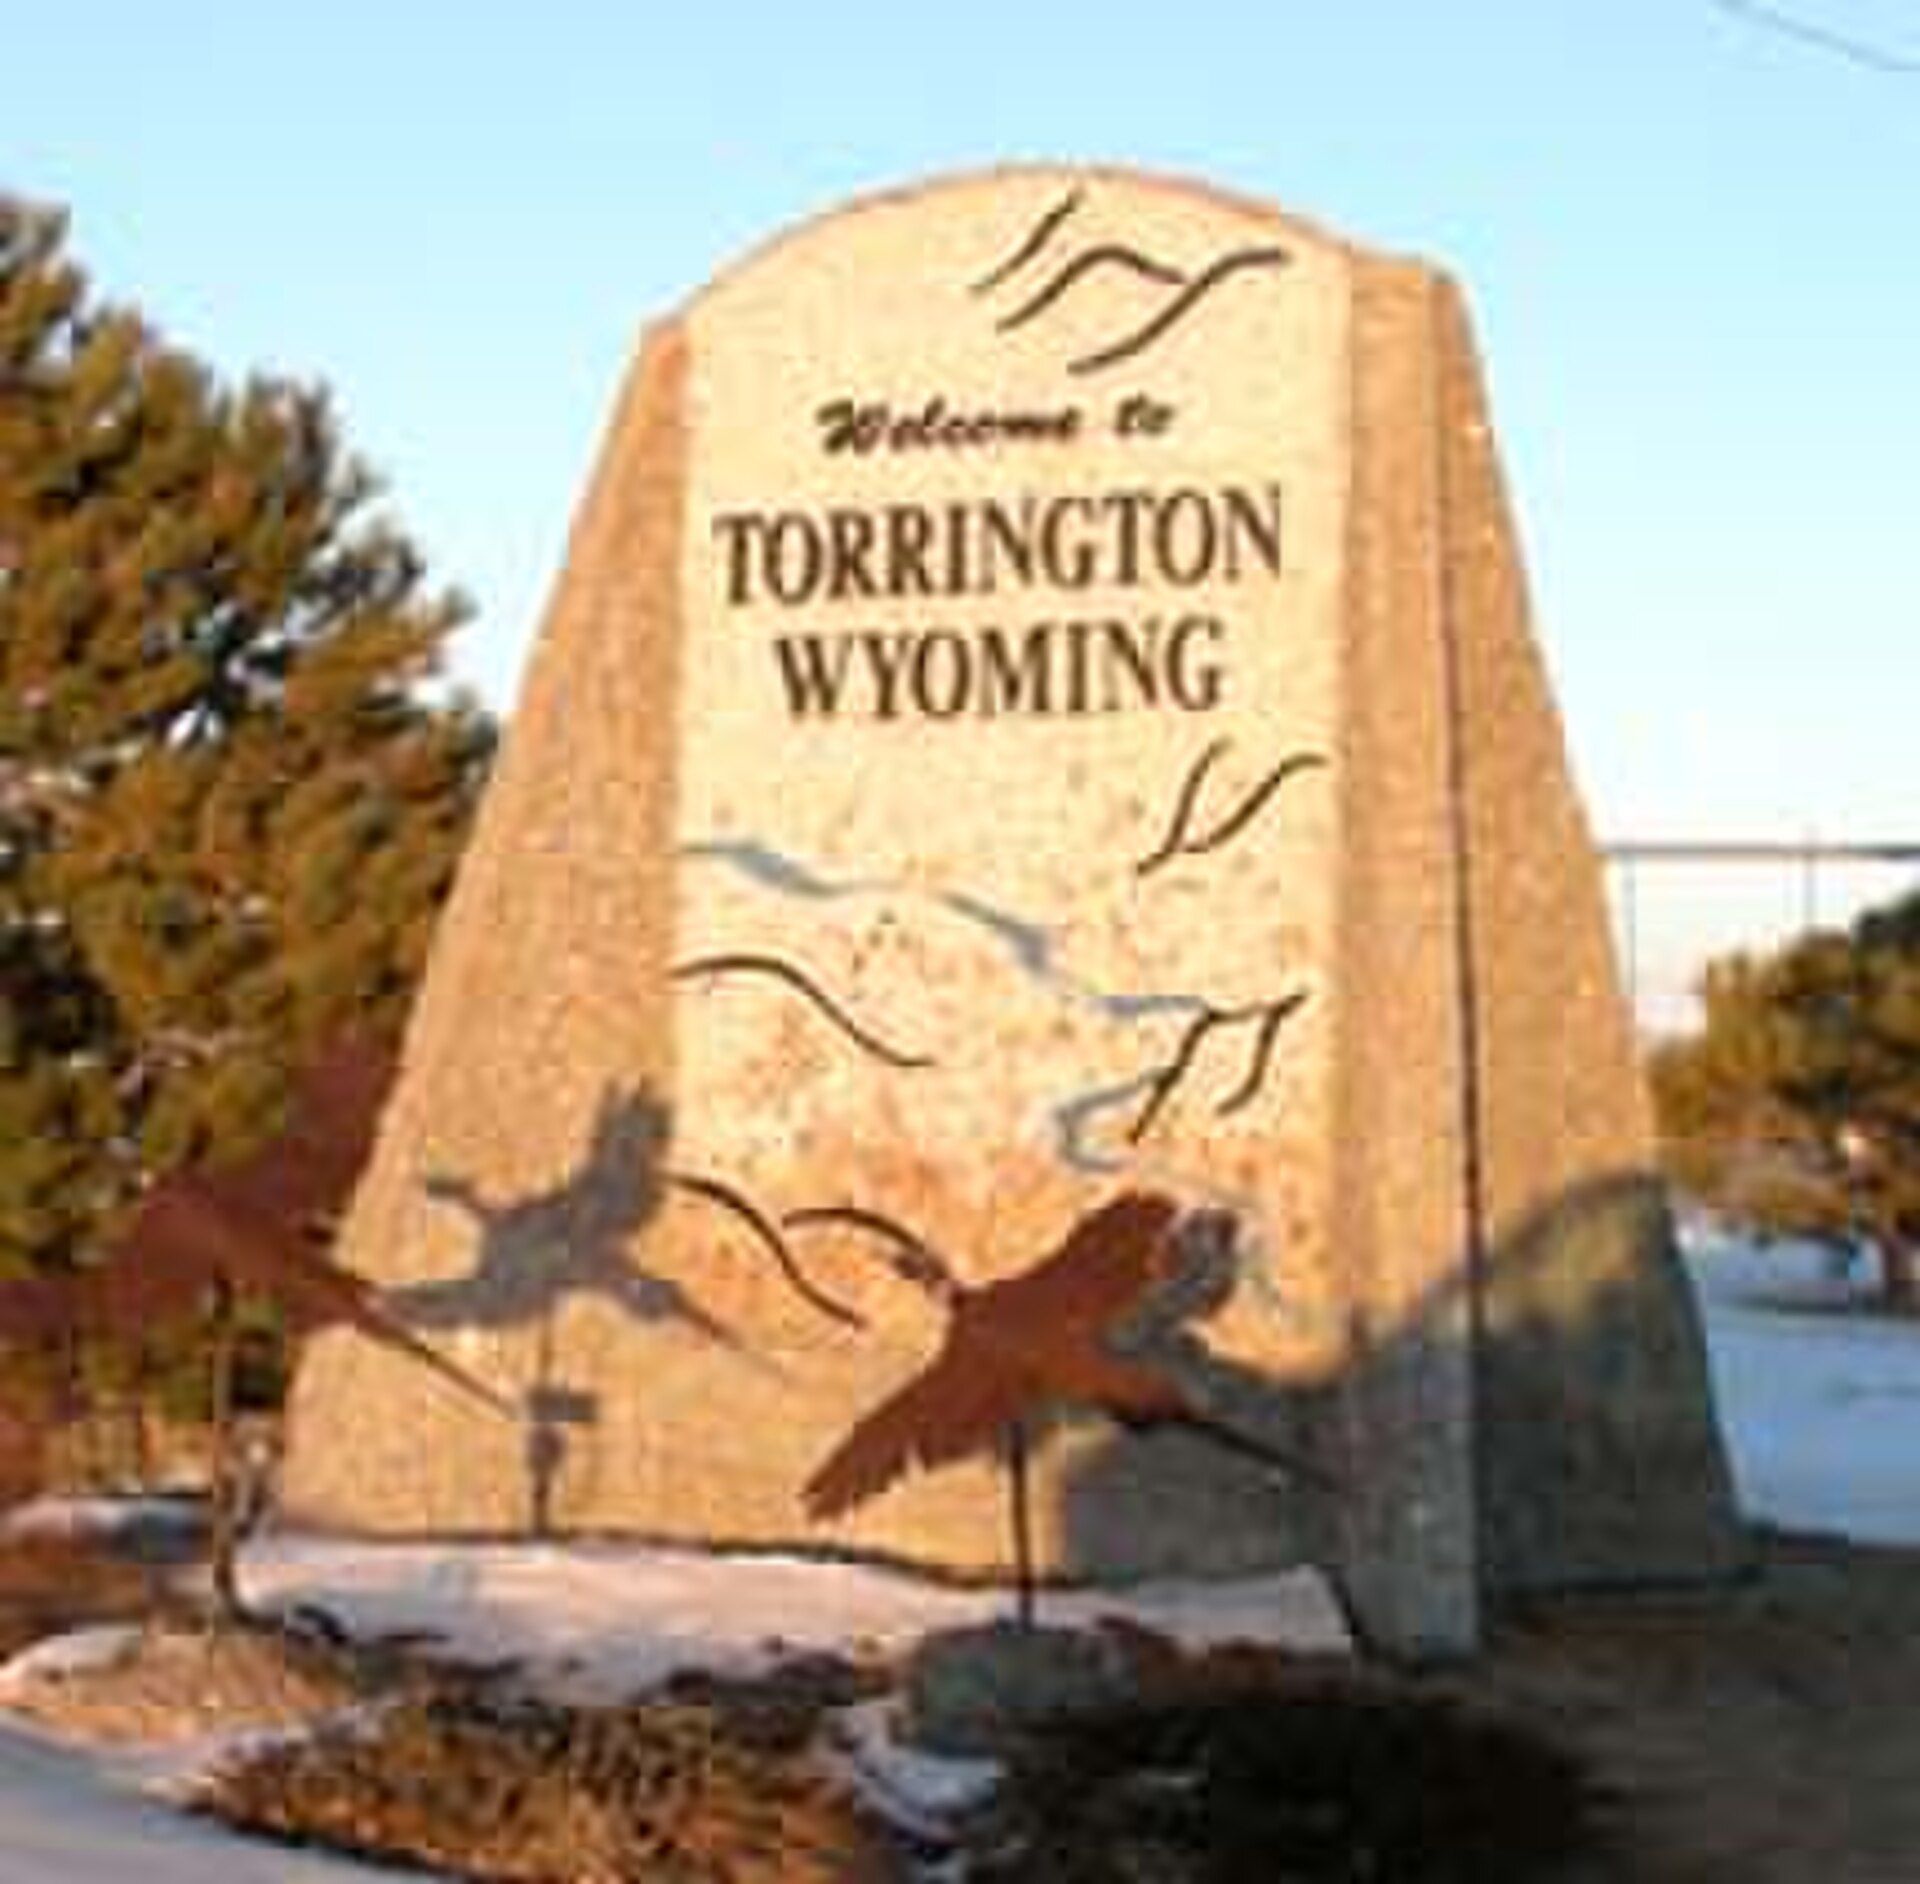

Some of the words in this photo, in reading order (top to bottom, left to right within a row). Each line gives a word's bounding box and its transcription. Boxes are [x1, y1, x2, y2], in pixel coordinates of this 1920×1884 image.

[816, 396, 1081, 455] Welcome
[1113, 394, 1174, 438] to
[711, 484, 1281, 607] TORRINGTON
[774, 615, 1223, 722] WYOMING
